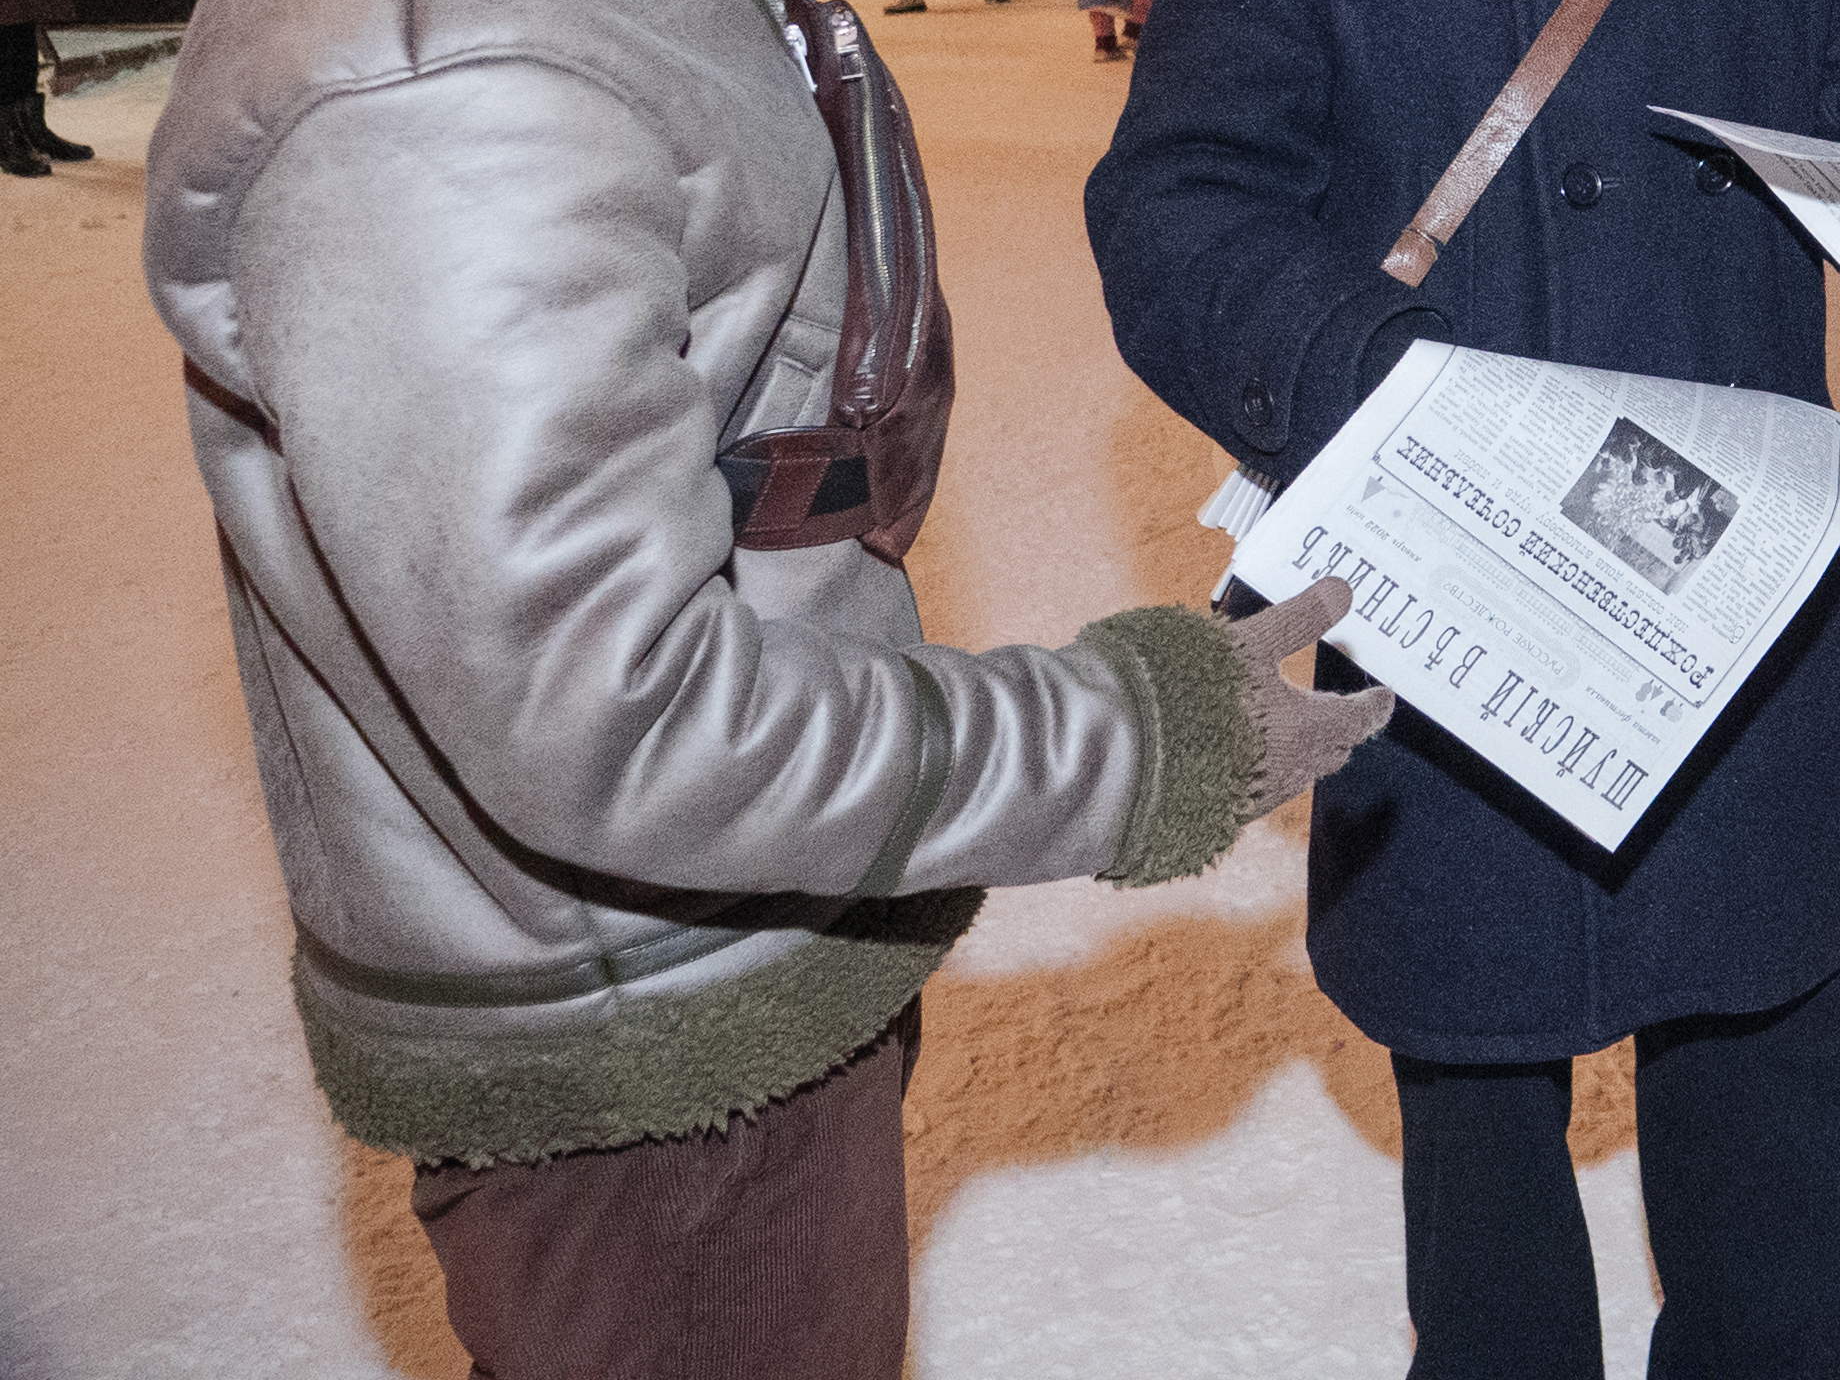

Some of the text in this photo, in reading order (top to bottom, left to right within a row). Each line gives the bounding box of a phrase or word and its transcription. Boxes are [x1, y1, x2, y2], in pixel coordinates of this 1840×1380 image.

[1395, 434, 1524, 541] СОЧЕЛЬНИК
[1490, 475, 1503, 490] и
[1503, 485, 1535, 515] чуда
[1364, 518, 1391, 542] 2022
[1533, 509, 1595, 562] атмосферу
[1517, 529, 1715, 690] РОЖДЕСТВЕНСКИЙ
[1479, 667, 1650, 811] ШУЙСКІЙ
